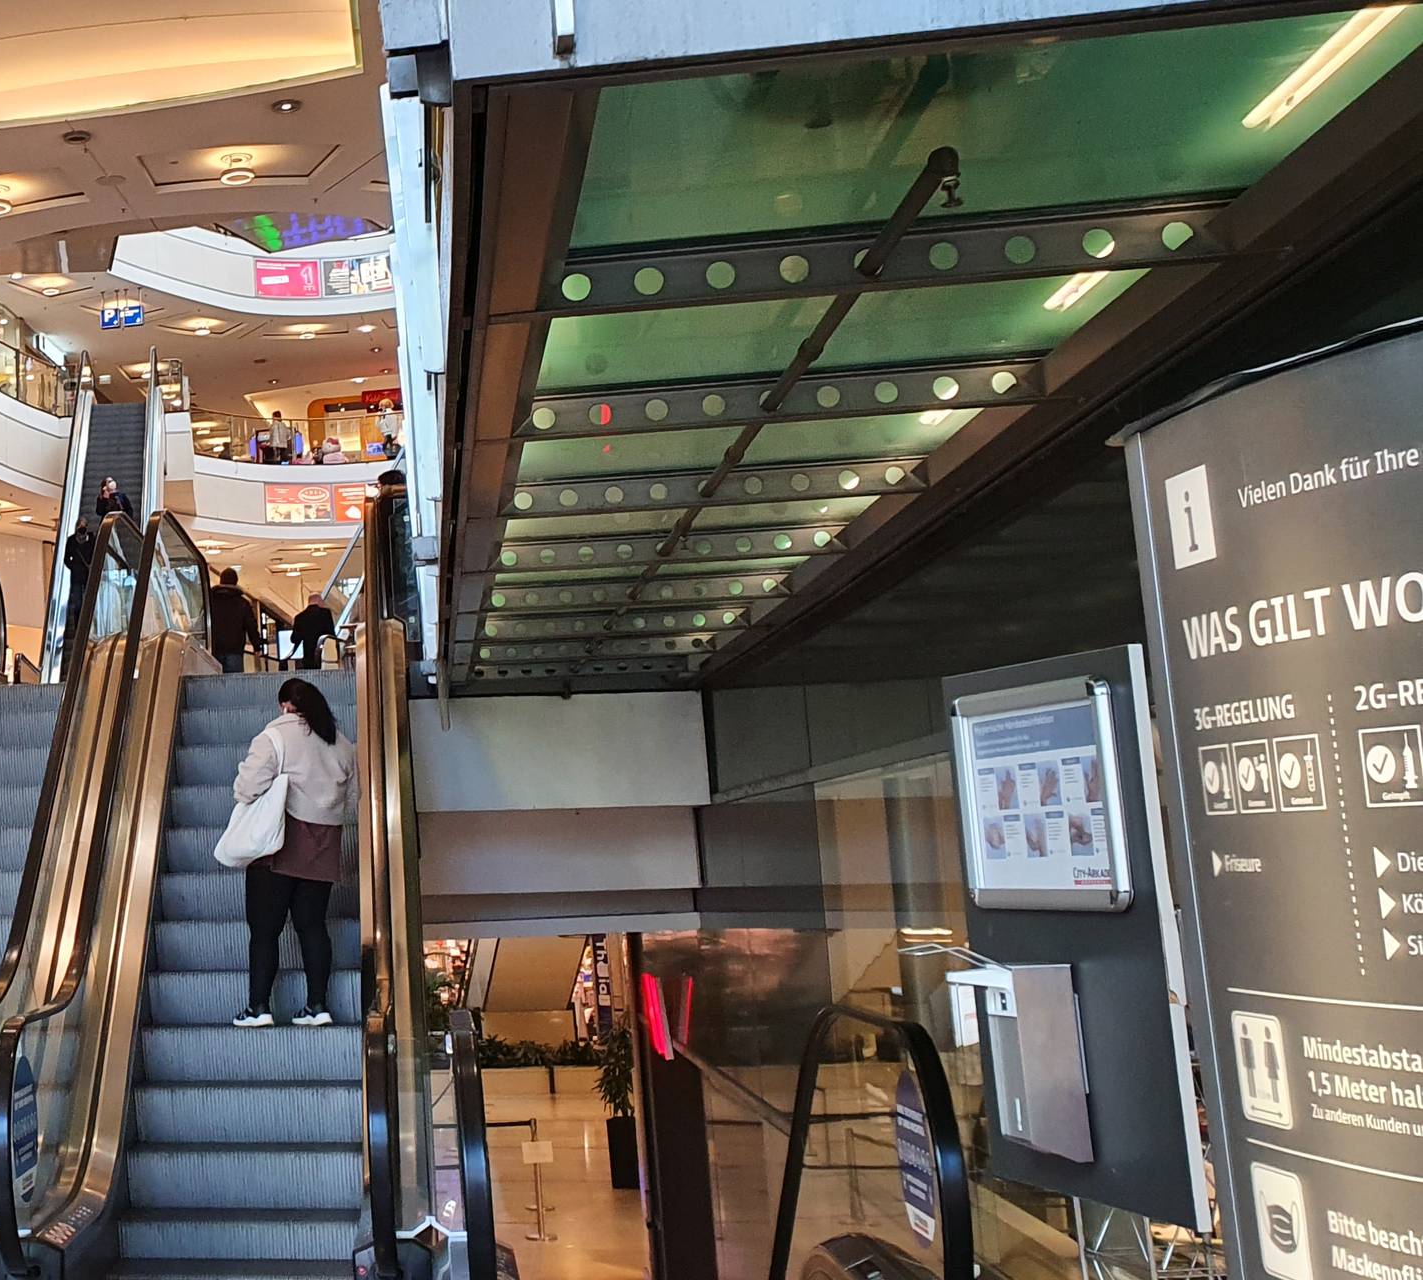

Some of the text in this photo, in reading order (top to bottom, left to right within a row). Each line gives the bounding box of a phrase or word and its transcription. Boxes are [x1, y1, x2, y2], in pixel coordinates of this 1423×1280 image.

[103, 309, 115, 323] P
[1237, 448, 1419, 508] Vielen Dank für Ihre
[1182, 572, 1423, 660] WAS GILT WO
[1193, 694, 1296, 731] 3G-REGELUNG
[1302, 1036, 1423, 1073] Mindestabsta
[1308, 1070, 1423, 1110] 1,5 Meter hal
[1310, 1103, 1423, 1137] Zu anderen Kunden u
[1327, 1210, 1423, 1257] Bitte beach
